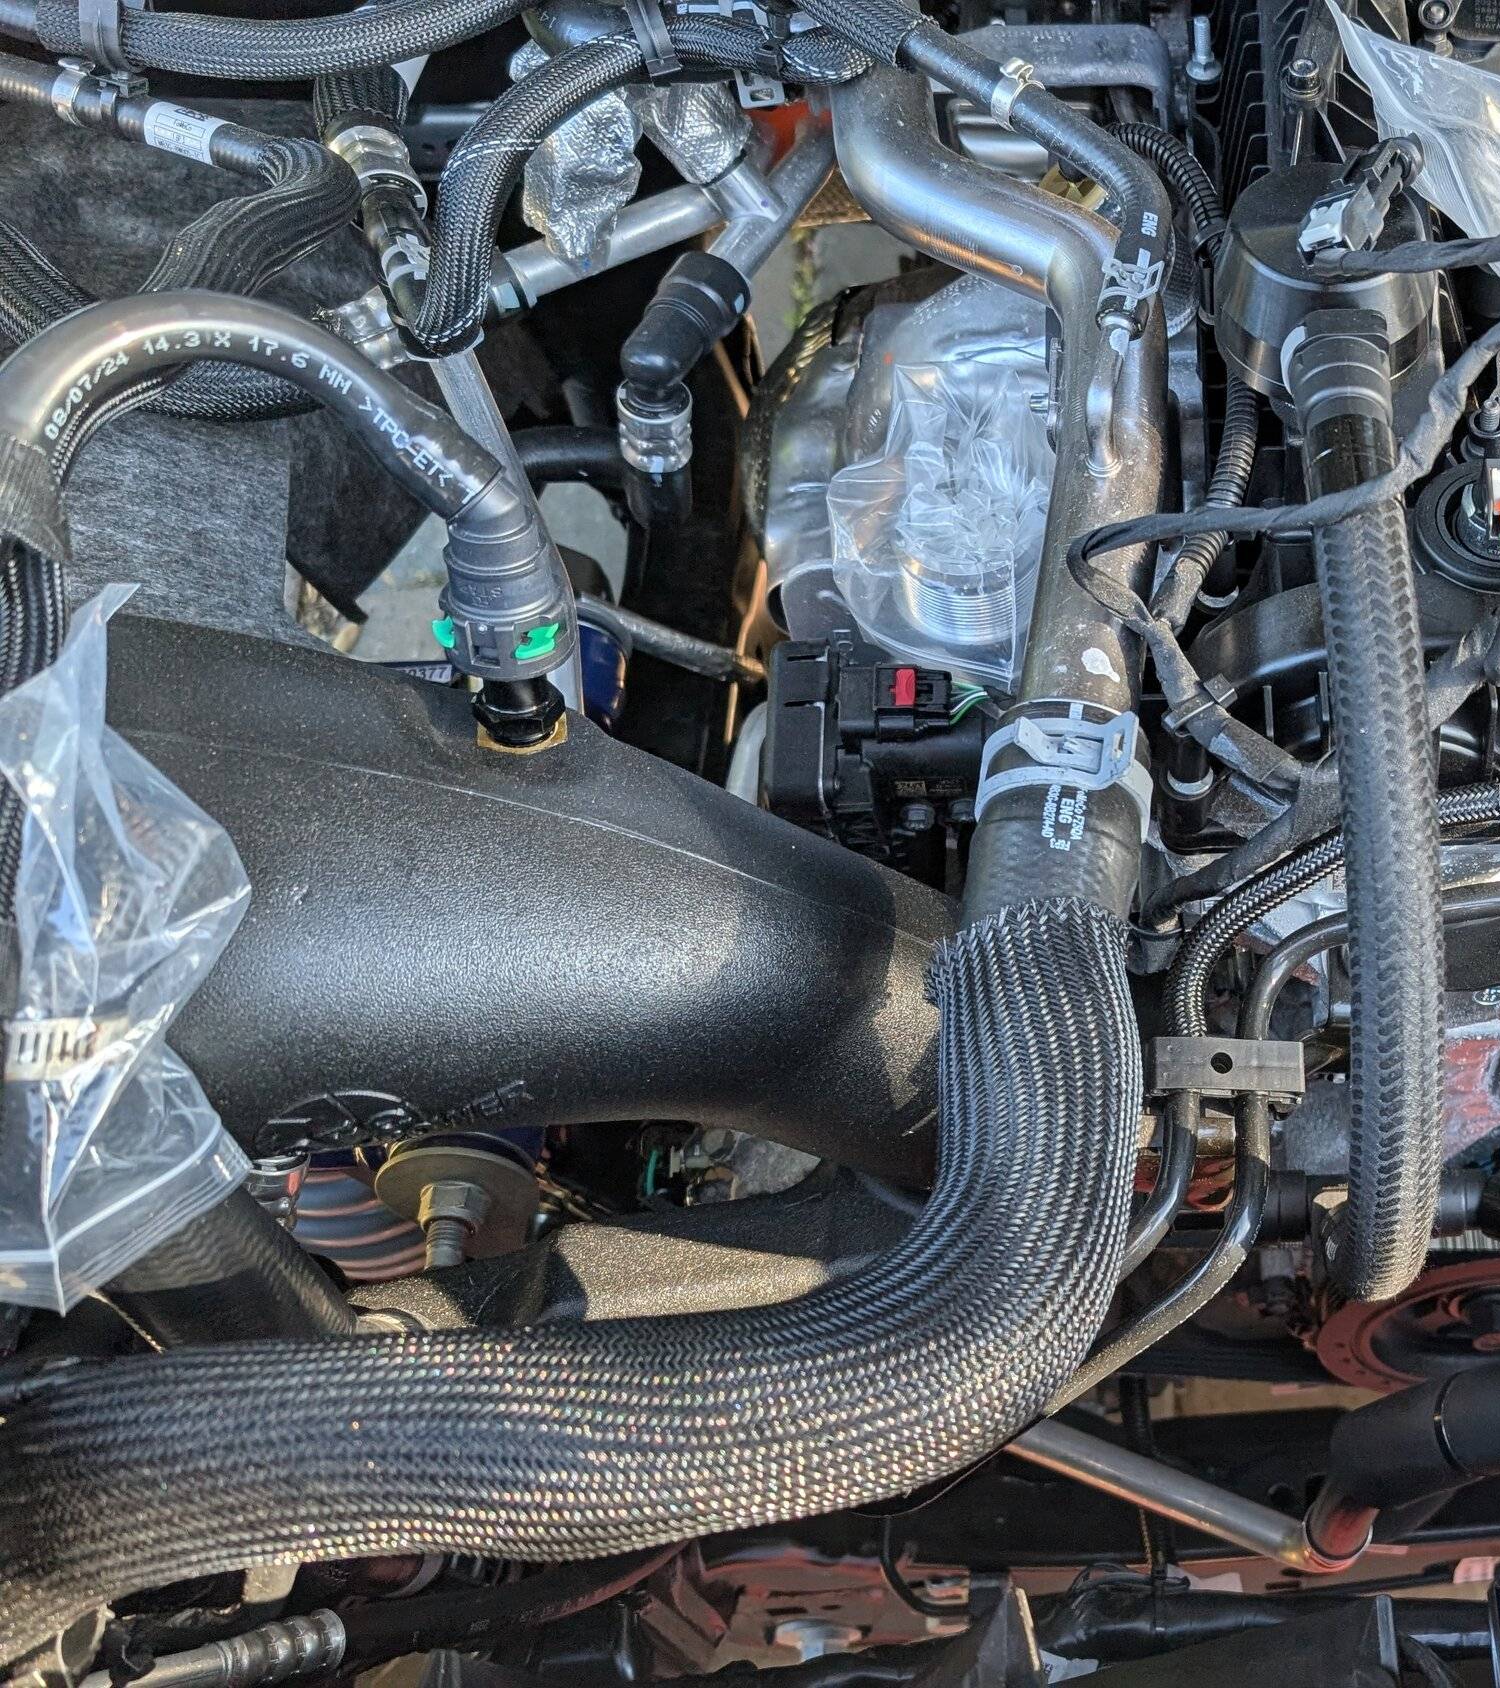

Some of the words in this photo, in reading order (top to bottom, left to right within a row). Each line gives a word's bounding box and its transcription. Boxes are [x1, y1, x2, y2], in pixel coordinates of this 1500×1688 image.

[1141, 211, 1159, 238] ENG
[44, 350, 130, 440] 08/07/24
[142, 330, 201, 356] 14.3
[248, 334, 312, 369] 17.6
[318, 363, 353, 395] MM
[1058, 798, 1075, 825] ENG
